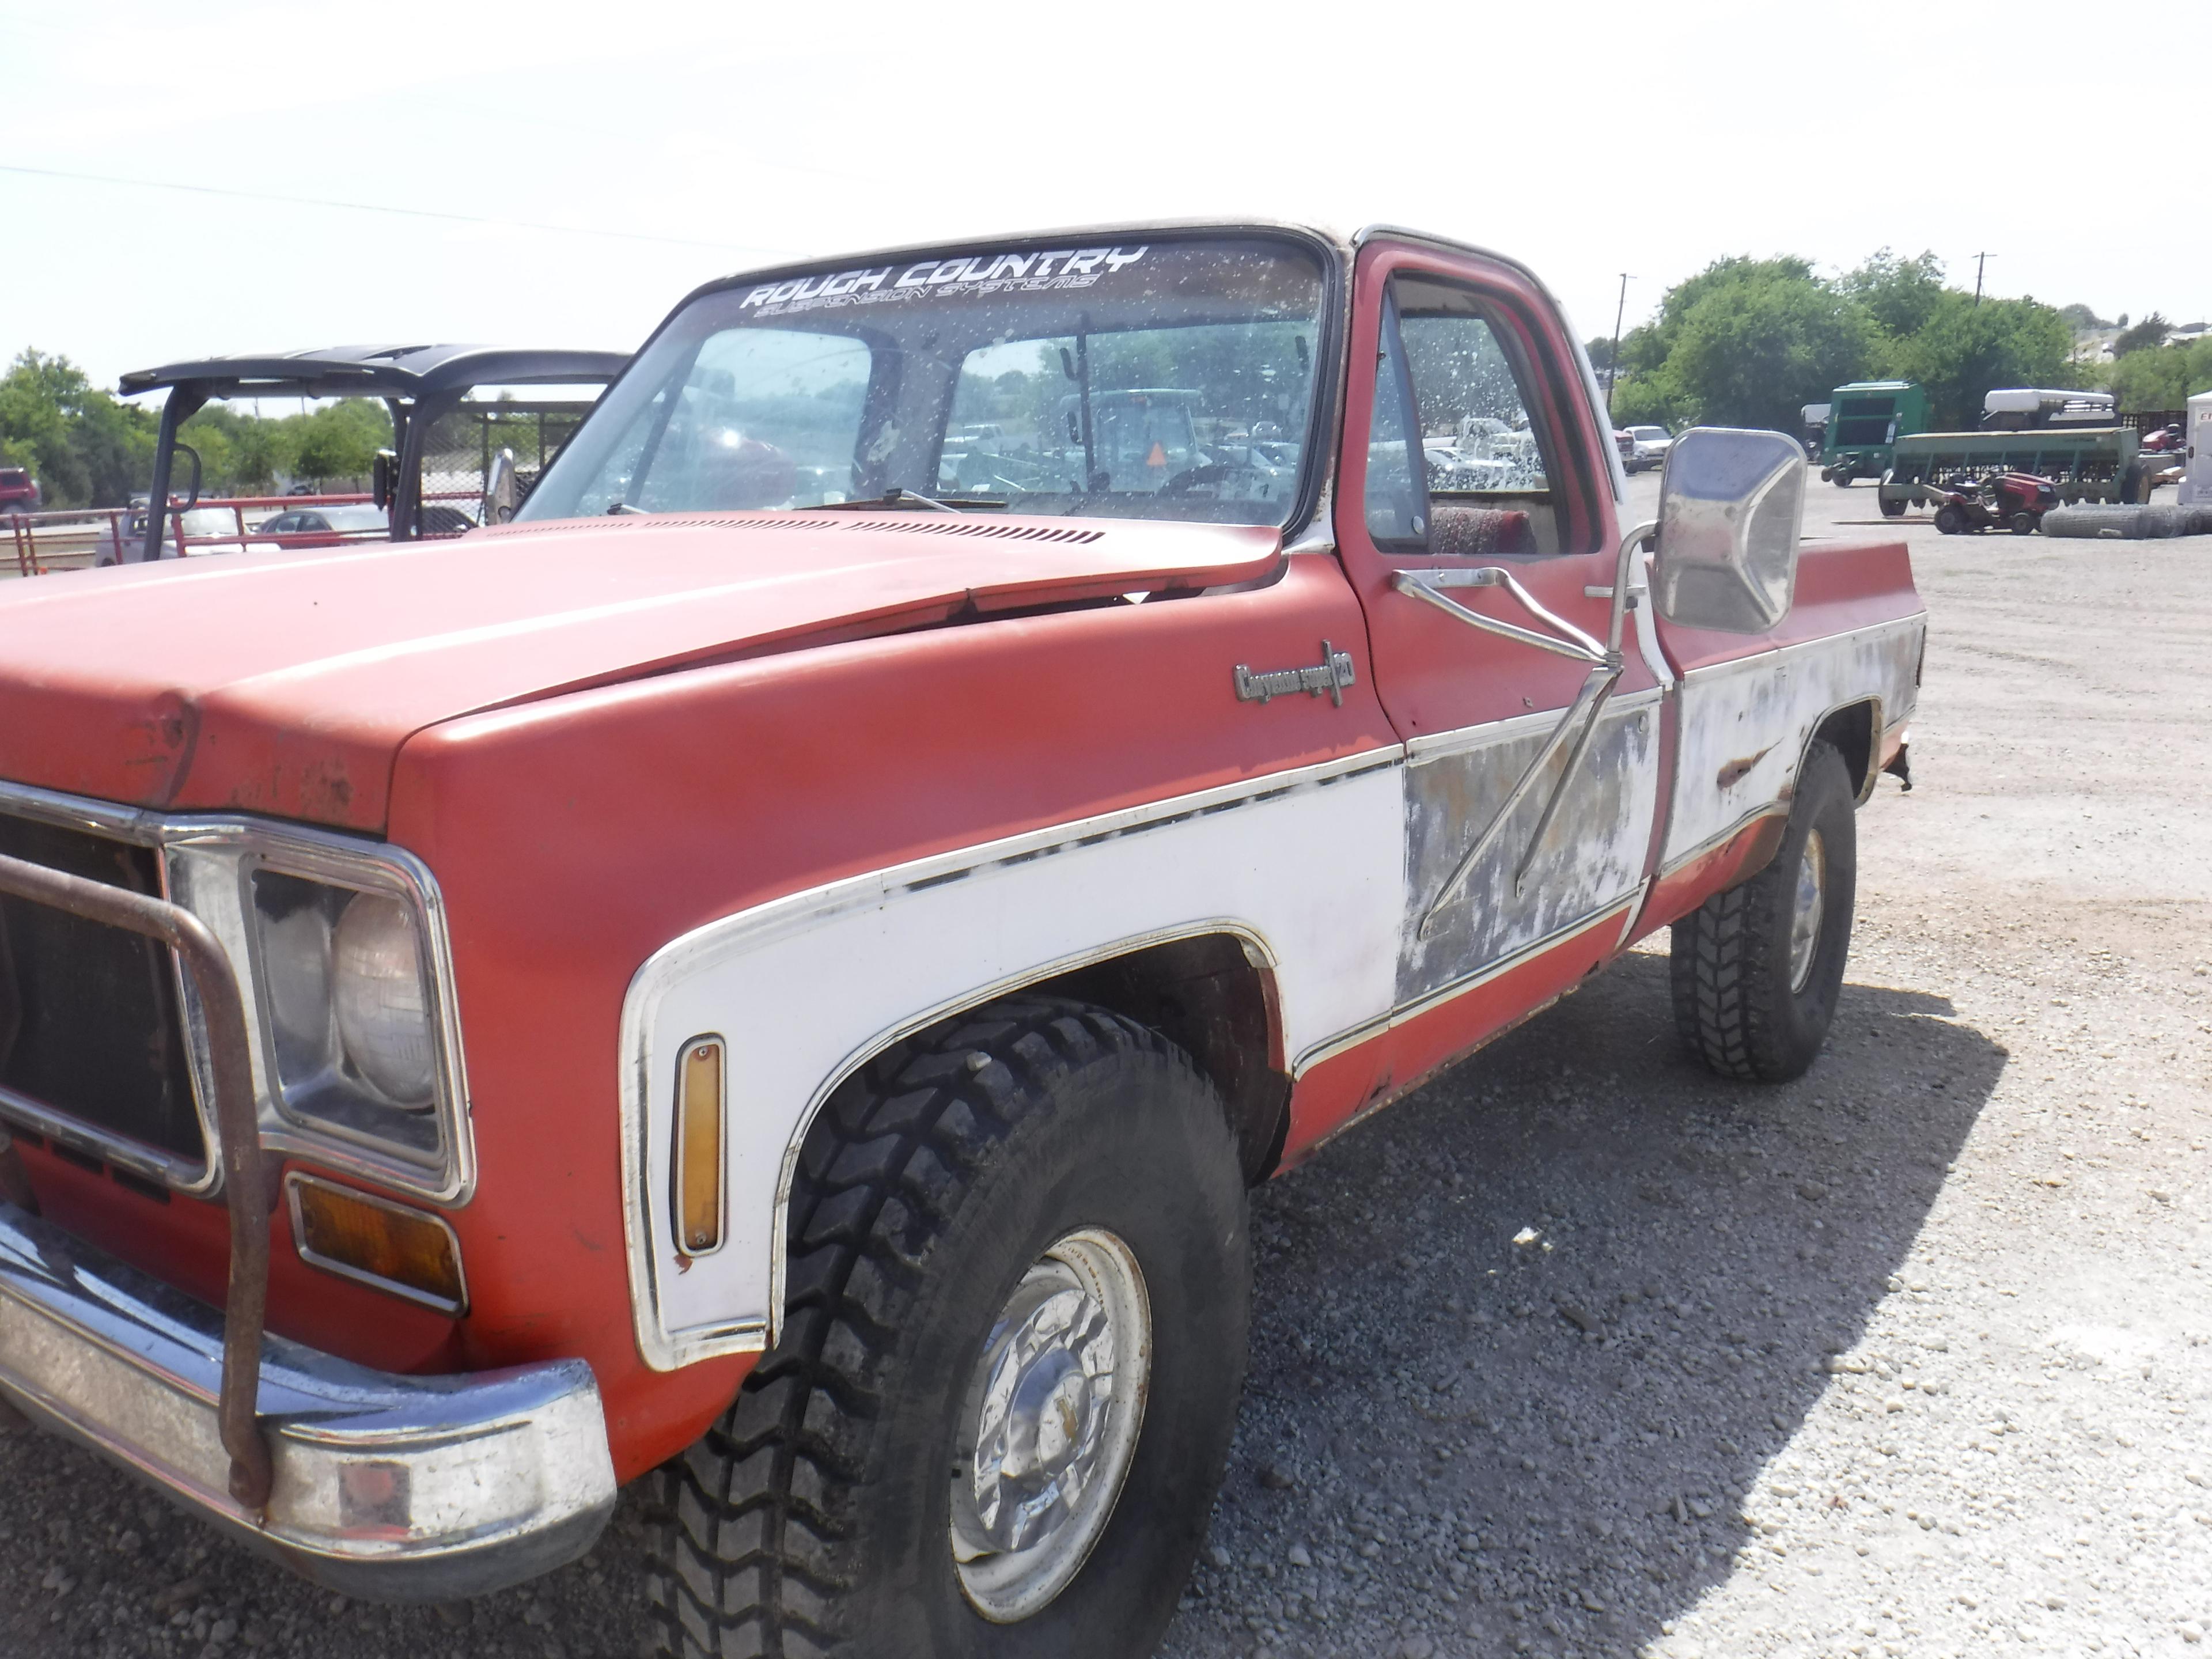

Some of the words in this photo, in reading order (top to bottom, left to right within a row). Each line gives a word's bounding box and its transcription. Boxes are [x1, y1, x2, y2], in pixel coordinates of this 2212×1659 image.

[739, 266, 893, 309] ROUGH
[893, 246, 1149, 288] COUNTRY
[753, 285, 933, 317] SUSPENSION
[935, 272, 1103, 295] SYSTEMS
